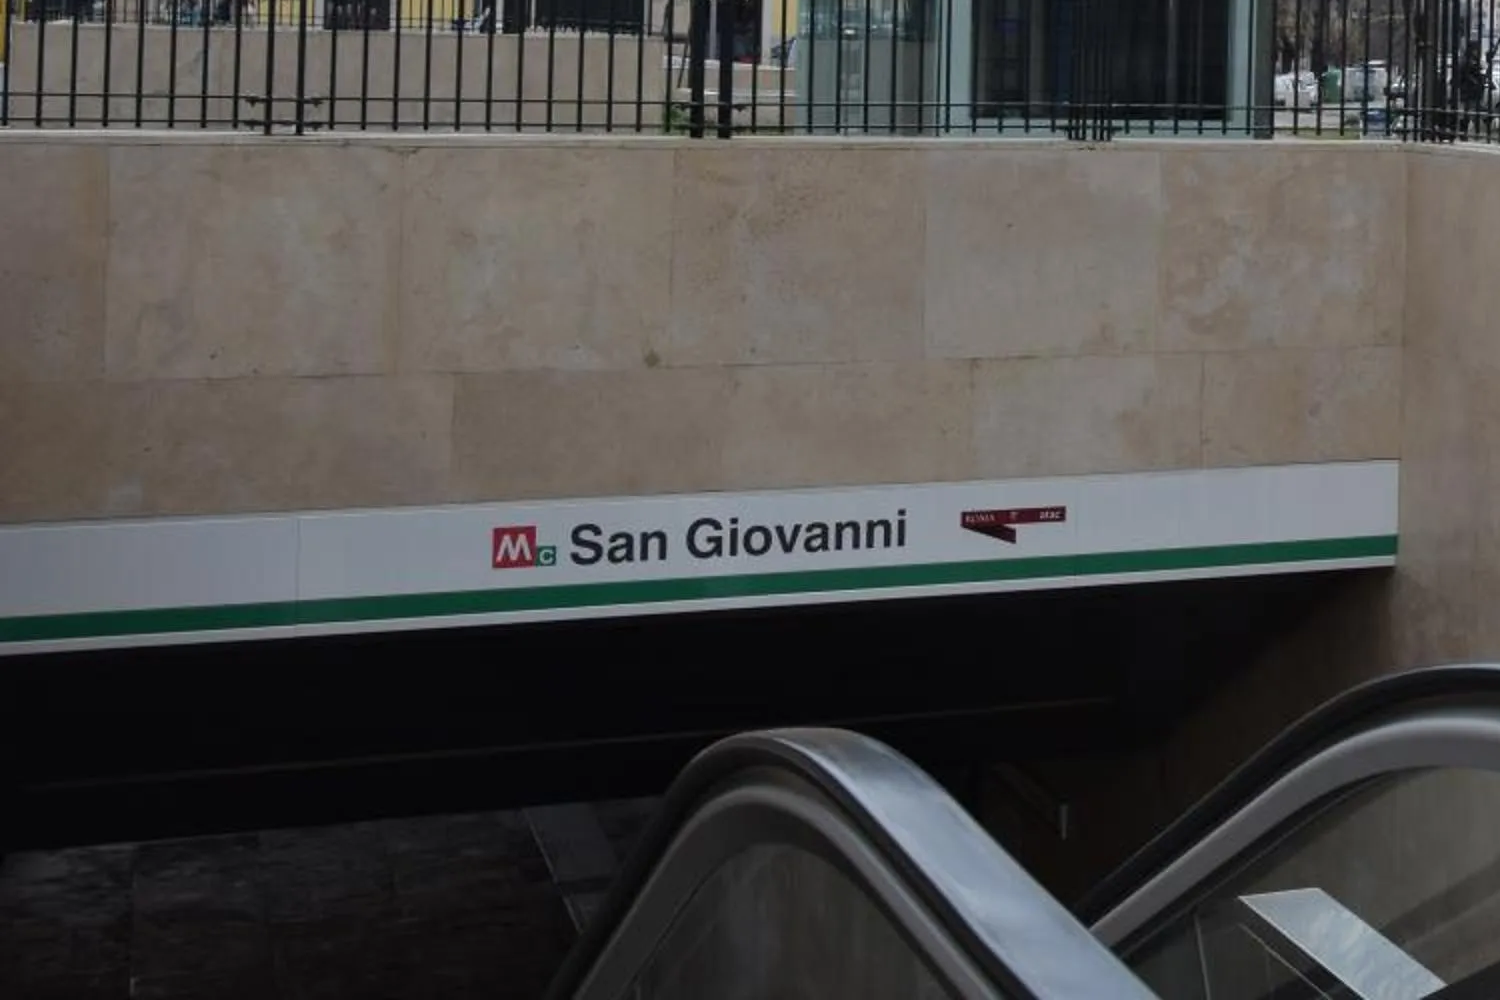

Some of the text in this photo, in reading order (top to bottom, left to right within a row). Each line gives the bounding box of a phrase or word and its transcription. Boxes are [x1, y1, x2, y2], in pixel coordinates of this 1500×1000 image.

[495, 533, 533, 562] M
[570, 523, 668, 566] San
[686, 508, 907, 560] Giovanni
